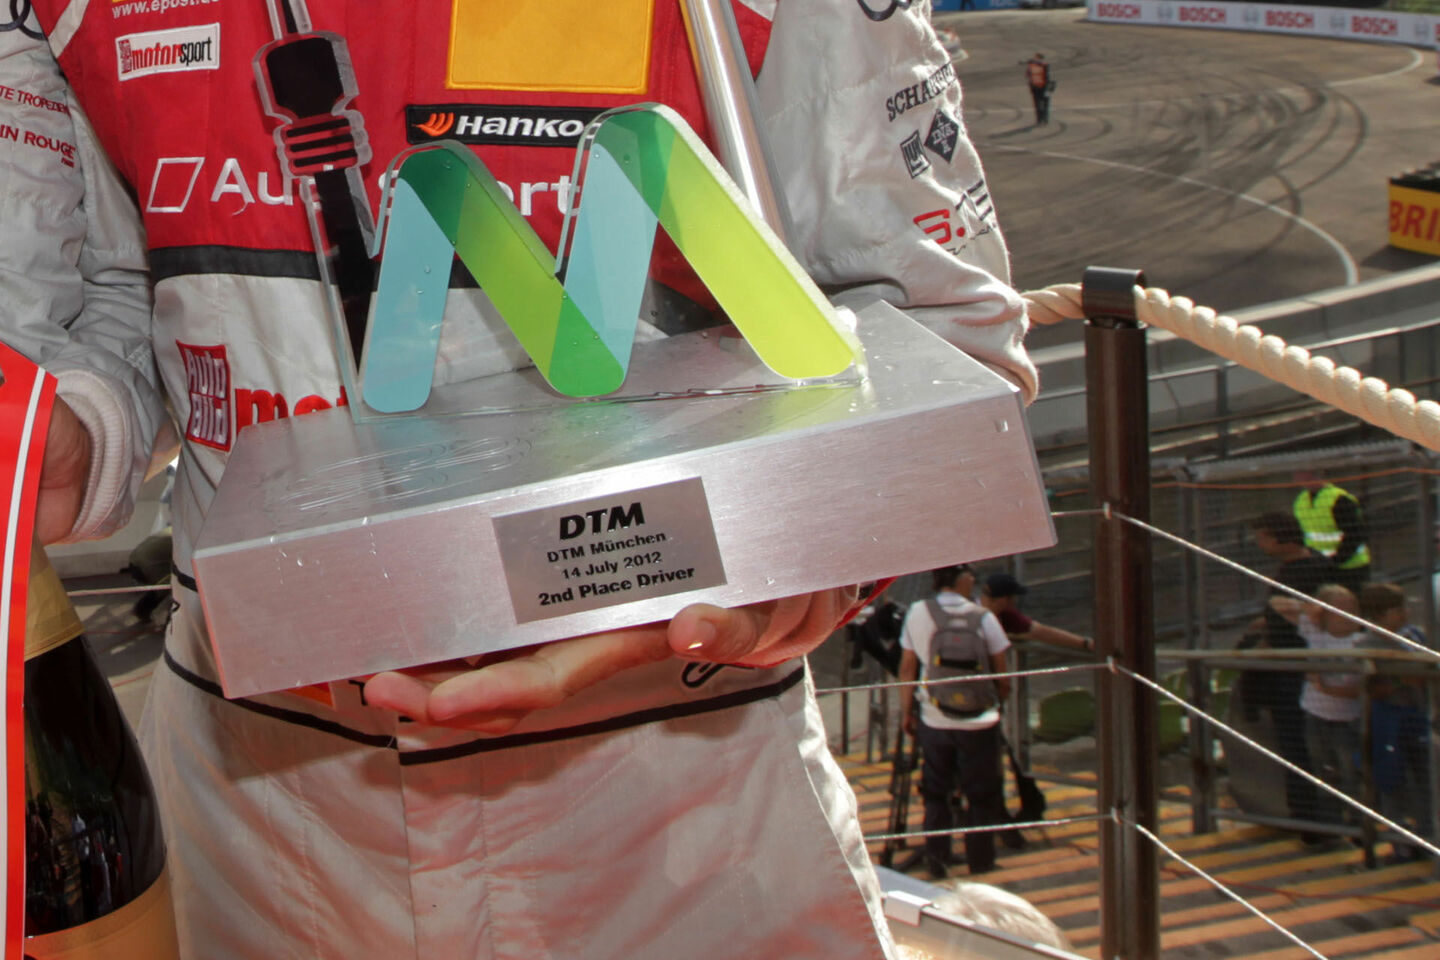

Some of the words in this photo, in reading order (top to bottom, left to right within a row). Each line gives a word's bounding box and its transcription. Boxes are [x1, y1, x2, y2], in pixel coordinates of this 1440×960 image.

[1097, 3, 1142, 19] BOSCH
[1179, 6, 1227, 23] BOSCH
[1265, 10, 1314, 29] BOSCH
[1351, 15, 1398, 36] BOSCH
[456, 114, 602, 140] Hanko
[23, 130, 77, 160] ROUGE
[1389, 200, 1440, 242] BRI
[559, 502, 646, 541] DTM
[546, 545, 585, 564] DTM
[590, 532, 667, 555] München
[563, 567, 581, 580] 14
[585, 560, 618, 576] July
[623, 551, 663, 569] 2012
[538, 586, 574, 607] 2nd
[578, 579, 633, 599] Place
[637, 567, 695, 588] Driver
